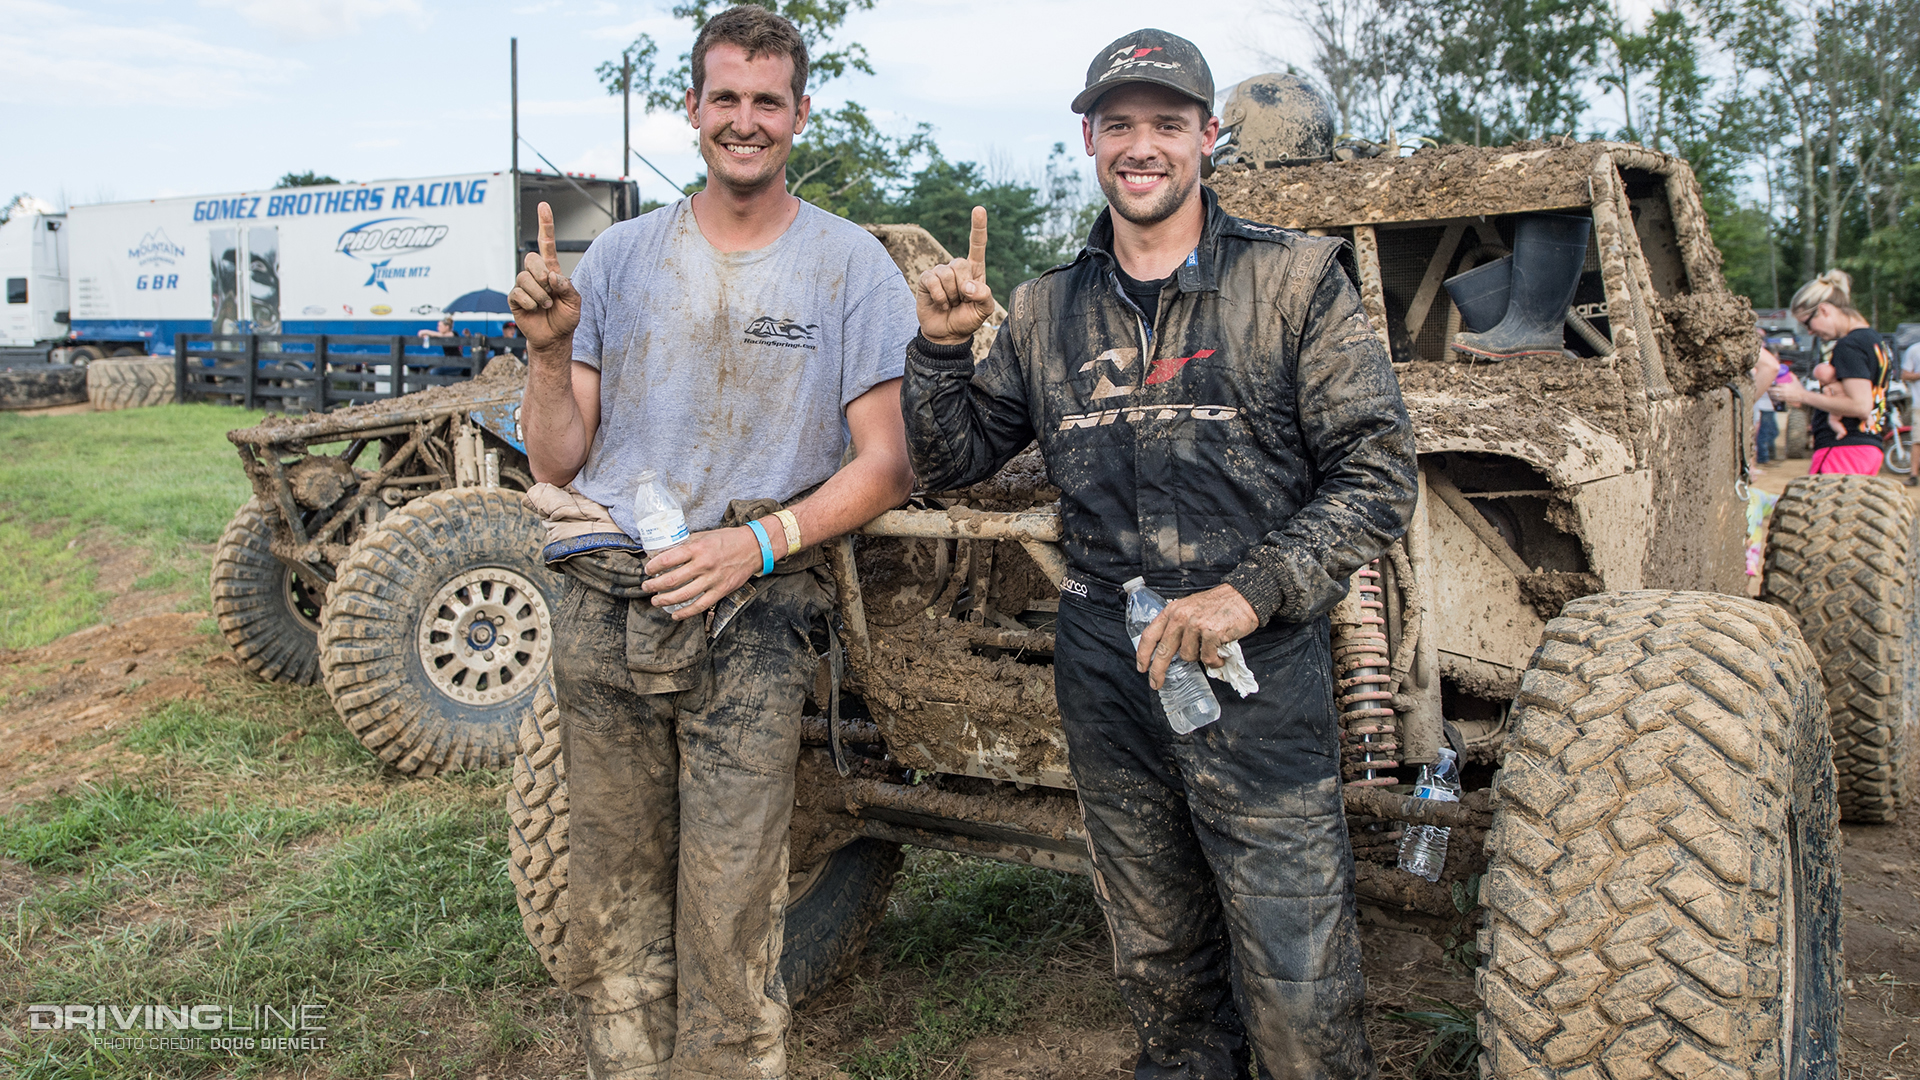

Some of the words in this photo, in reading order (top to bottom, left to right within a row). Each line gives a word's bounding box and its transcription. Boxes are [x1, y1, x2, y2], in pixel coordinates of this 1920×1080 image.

[193, 197, 262, 221] GOMEZ
[267, 187, 386, 217] BROTHERS
[391, 179, 488, 209] RACING
[128, 242, 185, 258] MOUNTAIN
[336, 229, 382, 252] PRO
[381, 225, 449, 250] COMP
[408, 266, 431, 278] MT2
[1059, 403, 1238, 431] NITTO
